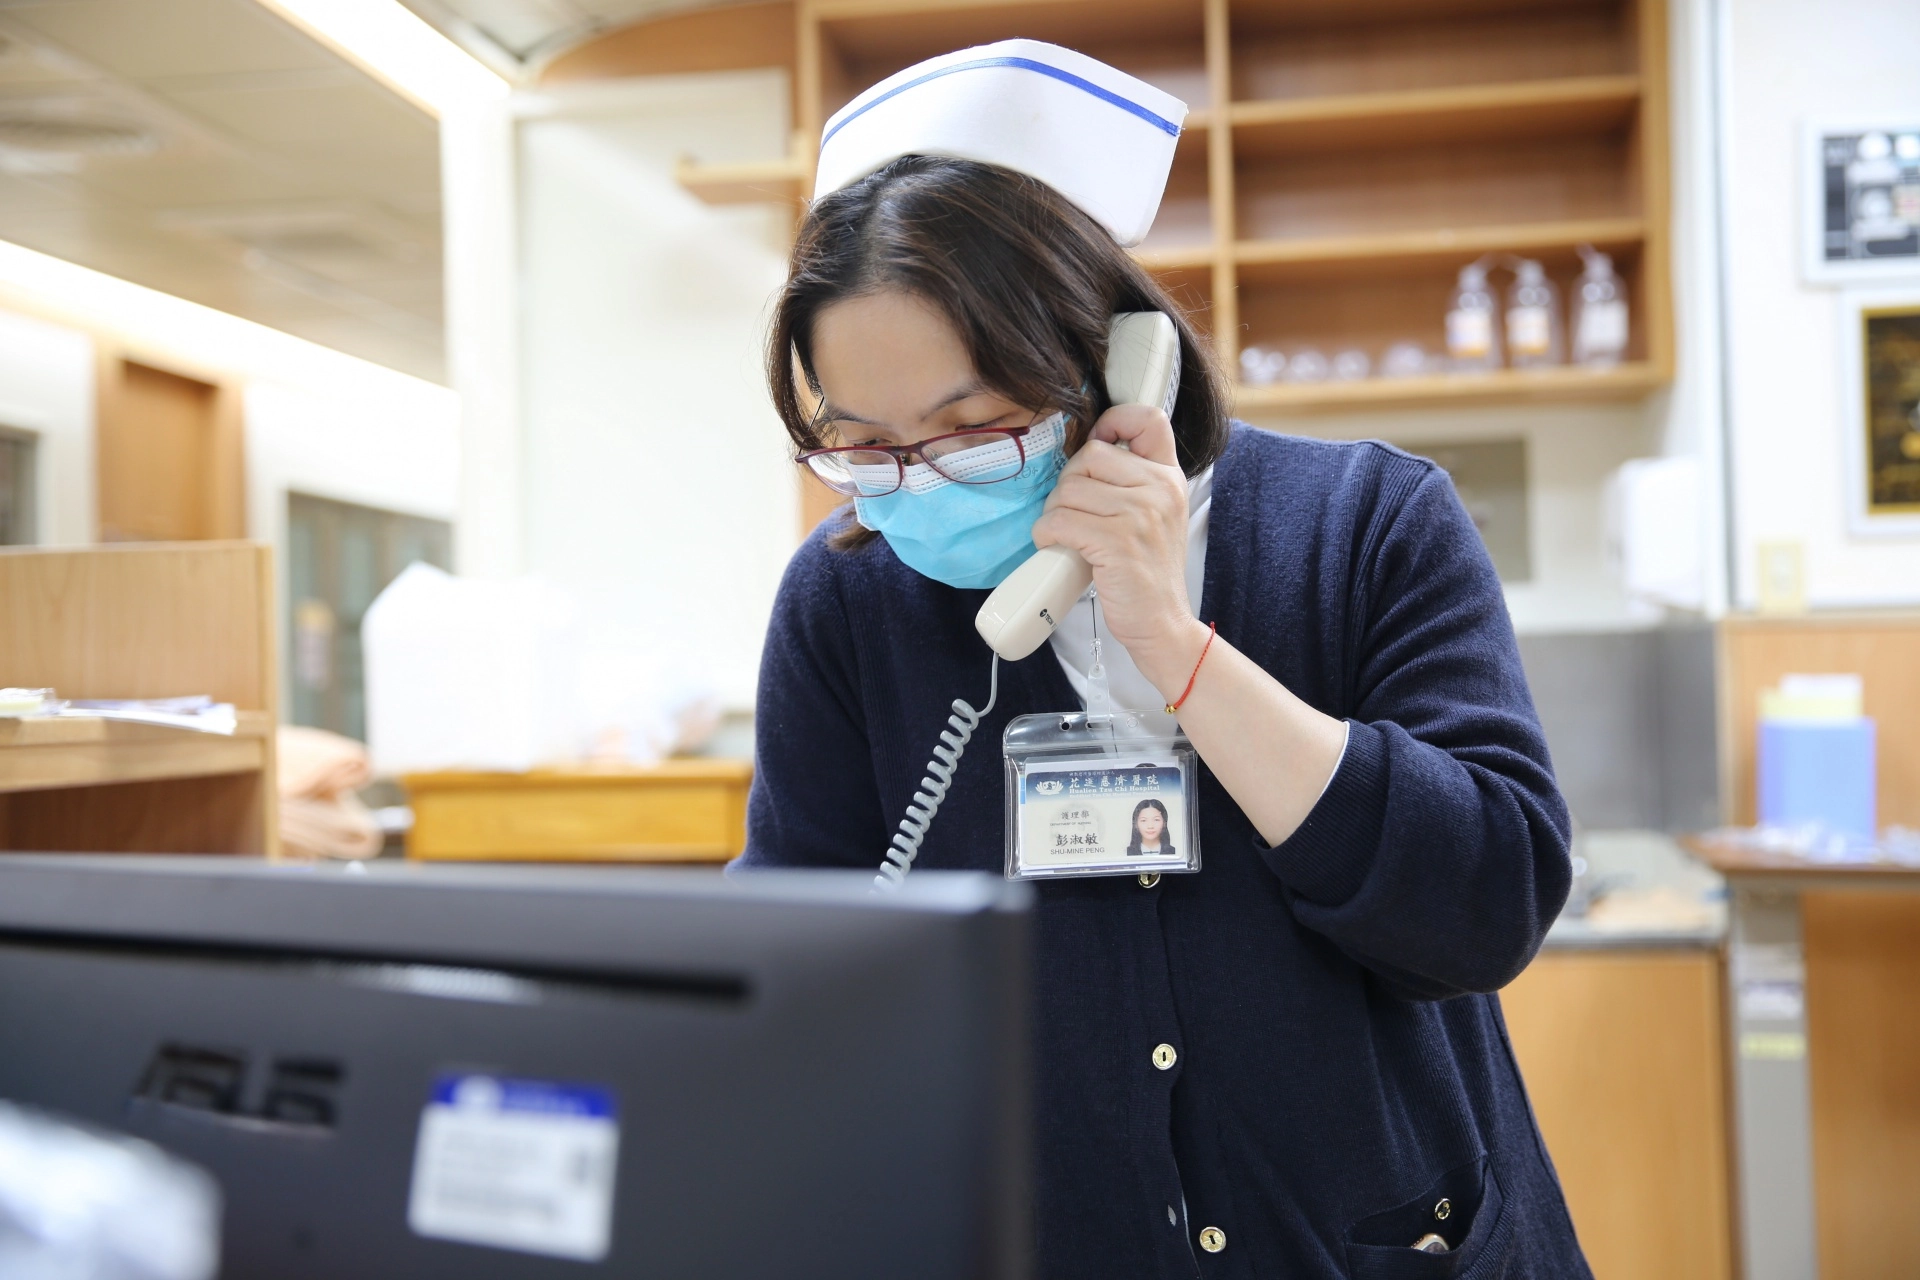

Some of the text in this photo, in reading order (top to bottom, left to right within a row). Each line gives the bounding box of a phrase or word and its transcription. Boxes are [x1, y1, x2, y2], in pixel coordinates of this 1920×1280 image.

[1069, 774, 1159, 788] 花蓮慈濟醫院
[1056, 833, 1099, 847] 彭淑敏
[1050, 846, 1105, 855] SHU-MINE PENG
